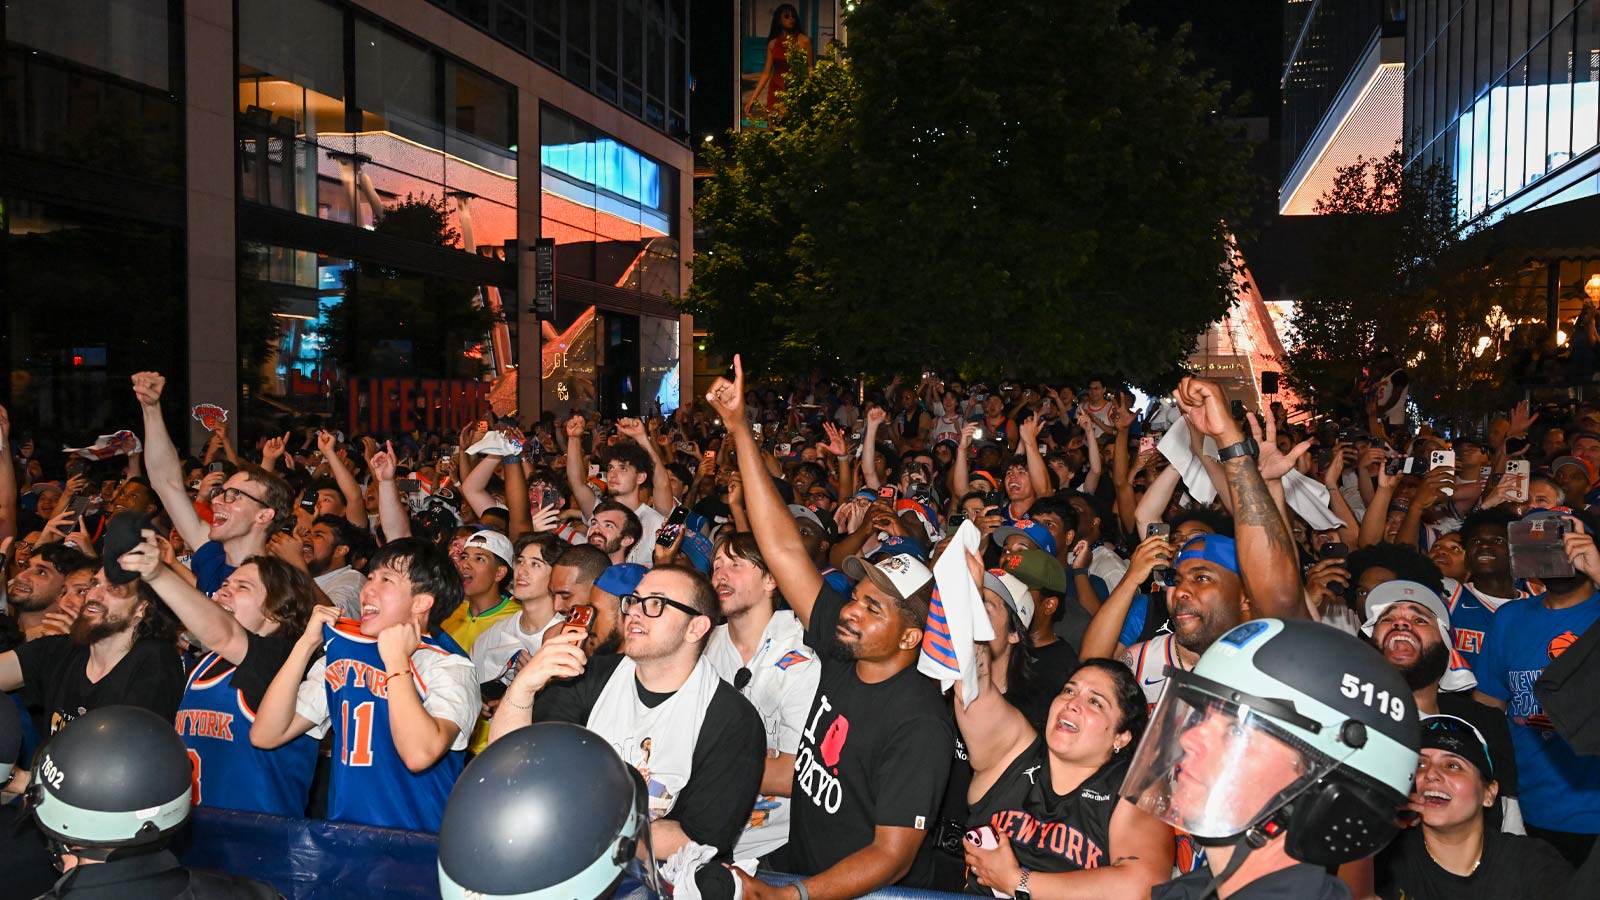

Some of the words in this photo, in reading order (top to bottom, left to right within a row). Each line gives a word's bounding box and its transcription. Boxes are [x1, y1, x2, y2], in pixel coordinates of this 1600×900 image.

[349, 378, 415, 434] LIFE
[422, 381, 491, 432] TIME
[352, 661, 390, 700] YOR
[1340, 672, 1405, 722] 5119
[189, 709, 234, 742] YORK
[342, 700, 375, 767] 11
[804, 695, 832, 745] I
[41, 753, 65, 790] 7602
[795, 742, 842, 814] OKYO
[991, 810, 1040, 844] NEW
[1037, 822, 1103, 870] YORK
